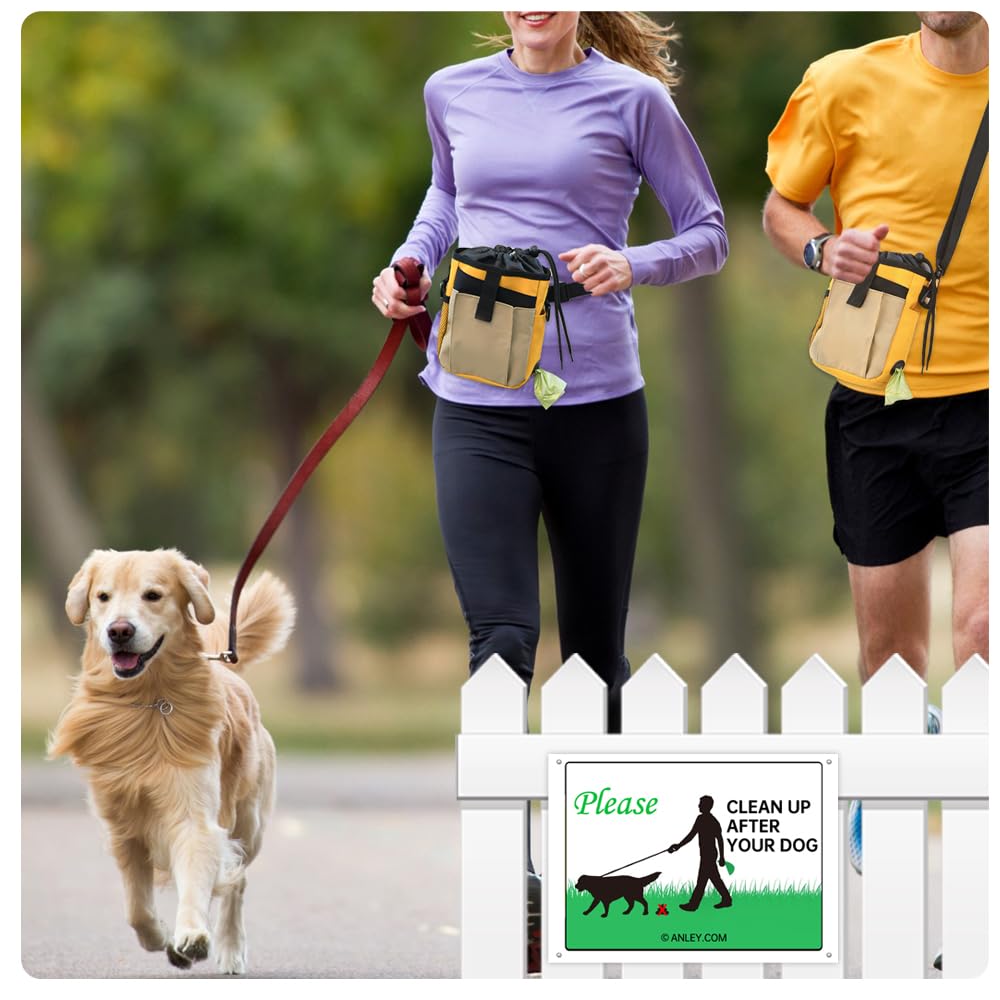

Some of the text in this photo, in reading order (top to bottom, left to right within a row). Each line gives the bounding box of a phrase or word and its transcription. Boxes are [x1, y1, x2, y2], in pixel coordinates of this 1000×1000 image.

[574, 787, 658, 815] Please
[727, 800, 810, 814] CLEAN UP
[727, 819, 780, 833] AFTER
[727, 838, 818, 852] YOUR DOG
[671, 933, 727, 942] ANLEY.COM
